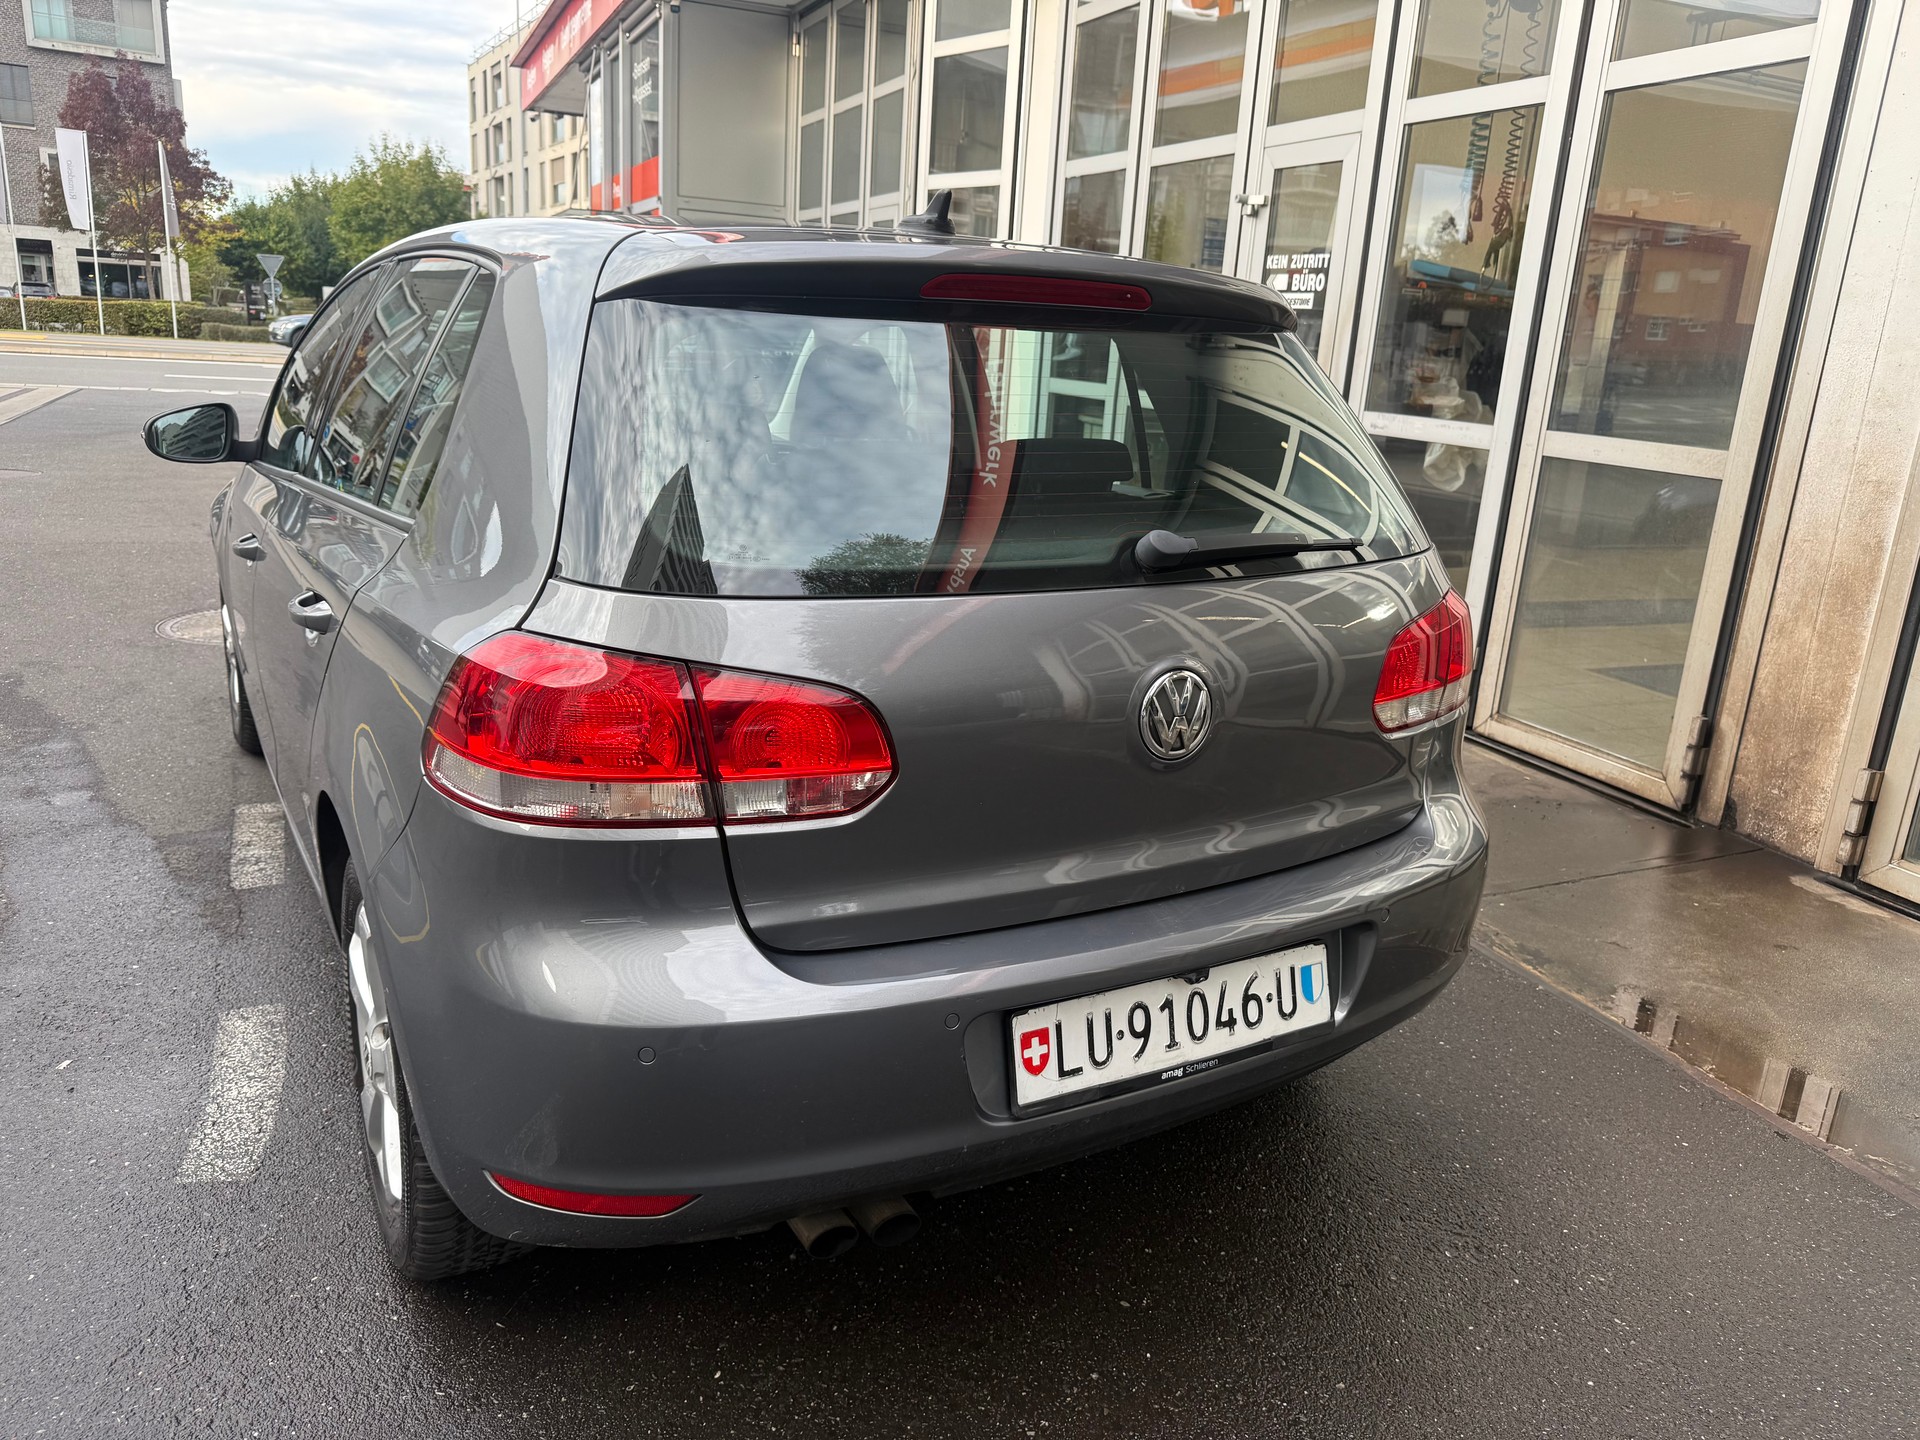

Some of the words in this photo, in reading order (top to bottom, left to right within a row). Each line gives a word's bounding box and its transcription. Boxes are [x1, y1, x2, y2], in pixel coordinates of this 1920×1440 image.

[1266, 254, 1288, 269] KEIN
[1290, 253, 1330, 269] ZUTRITT
[1291, 269, 1326, 292] BÜRO
[1161, 1067, 1184, 1080] amag
[1185, 1058, 1219, 1074] Schlieren
